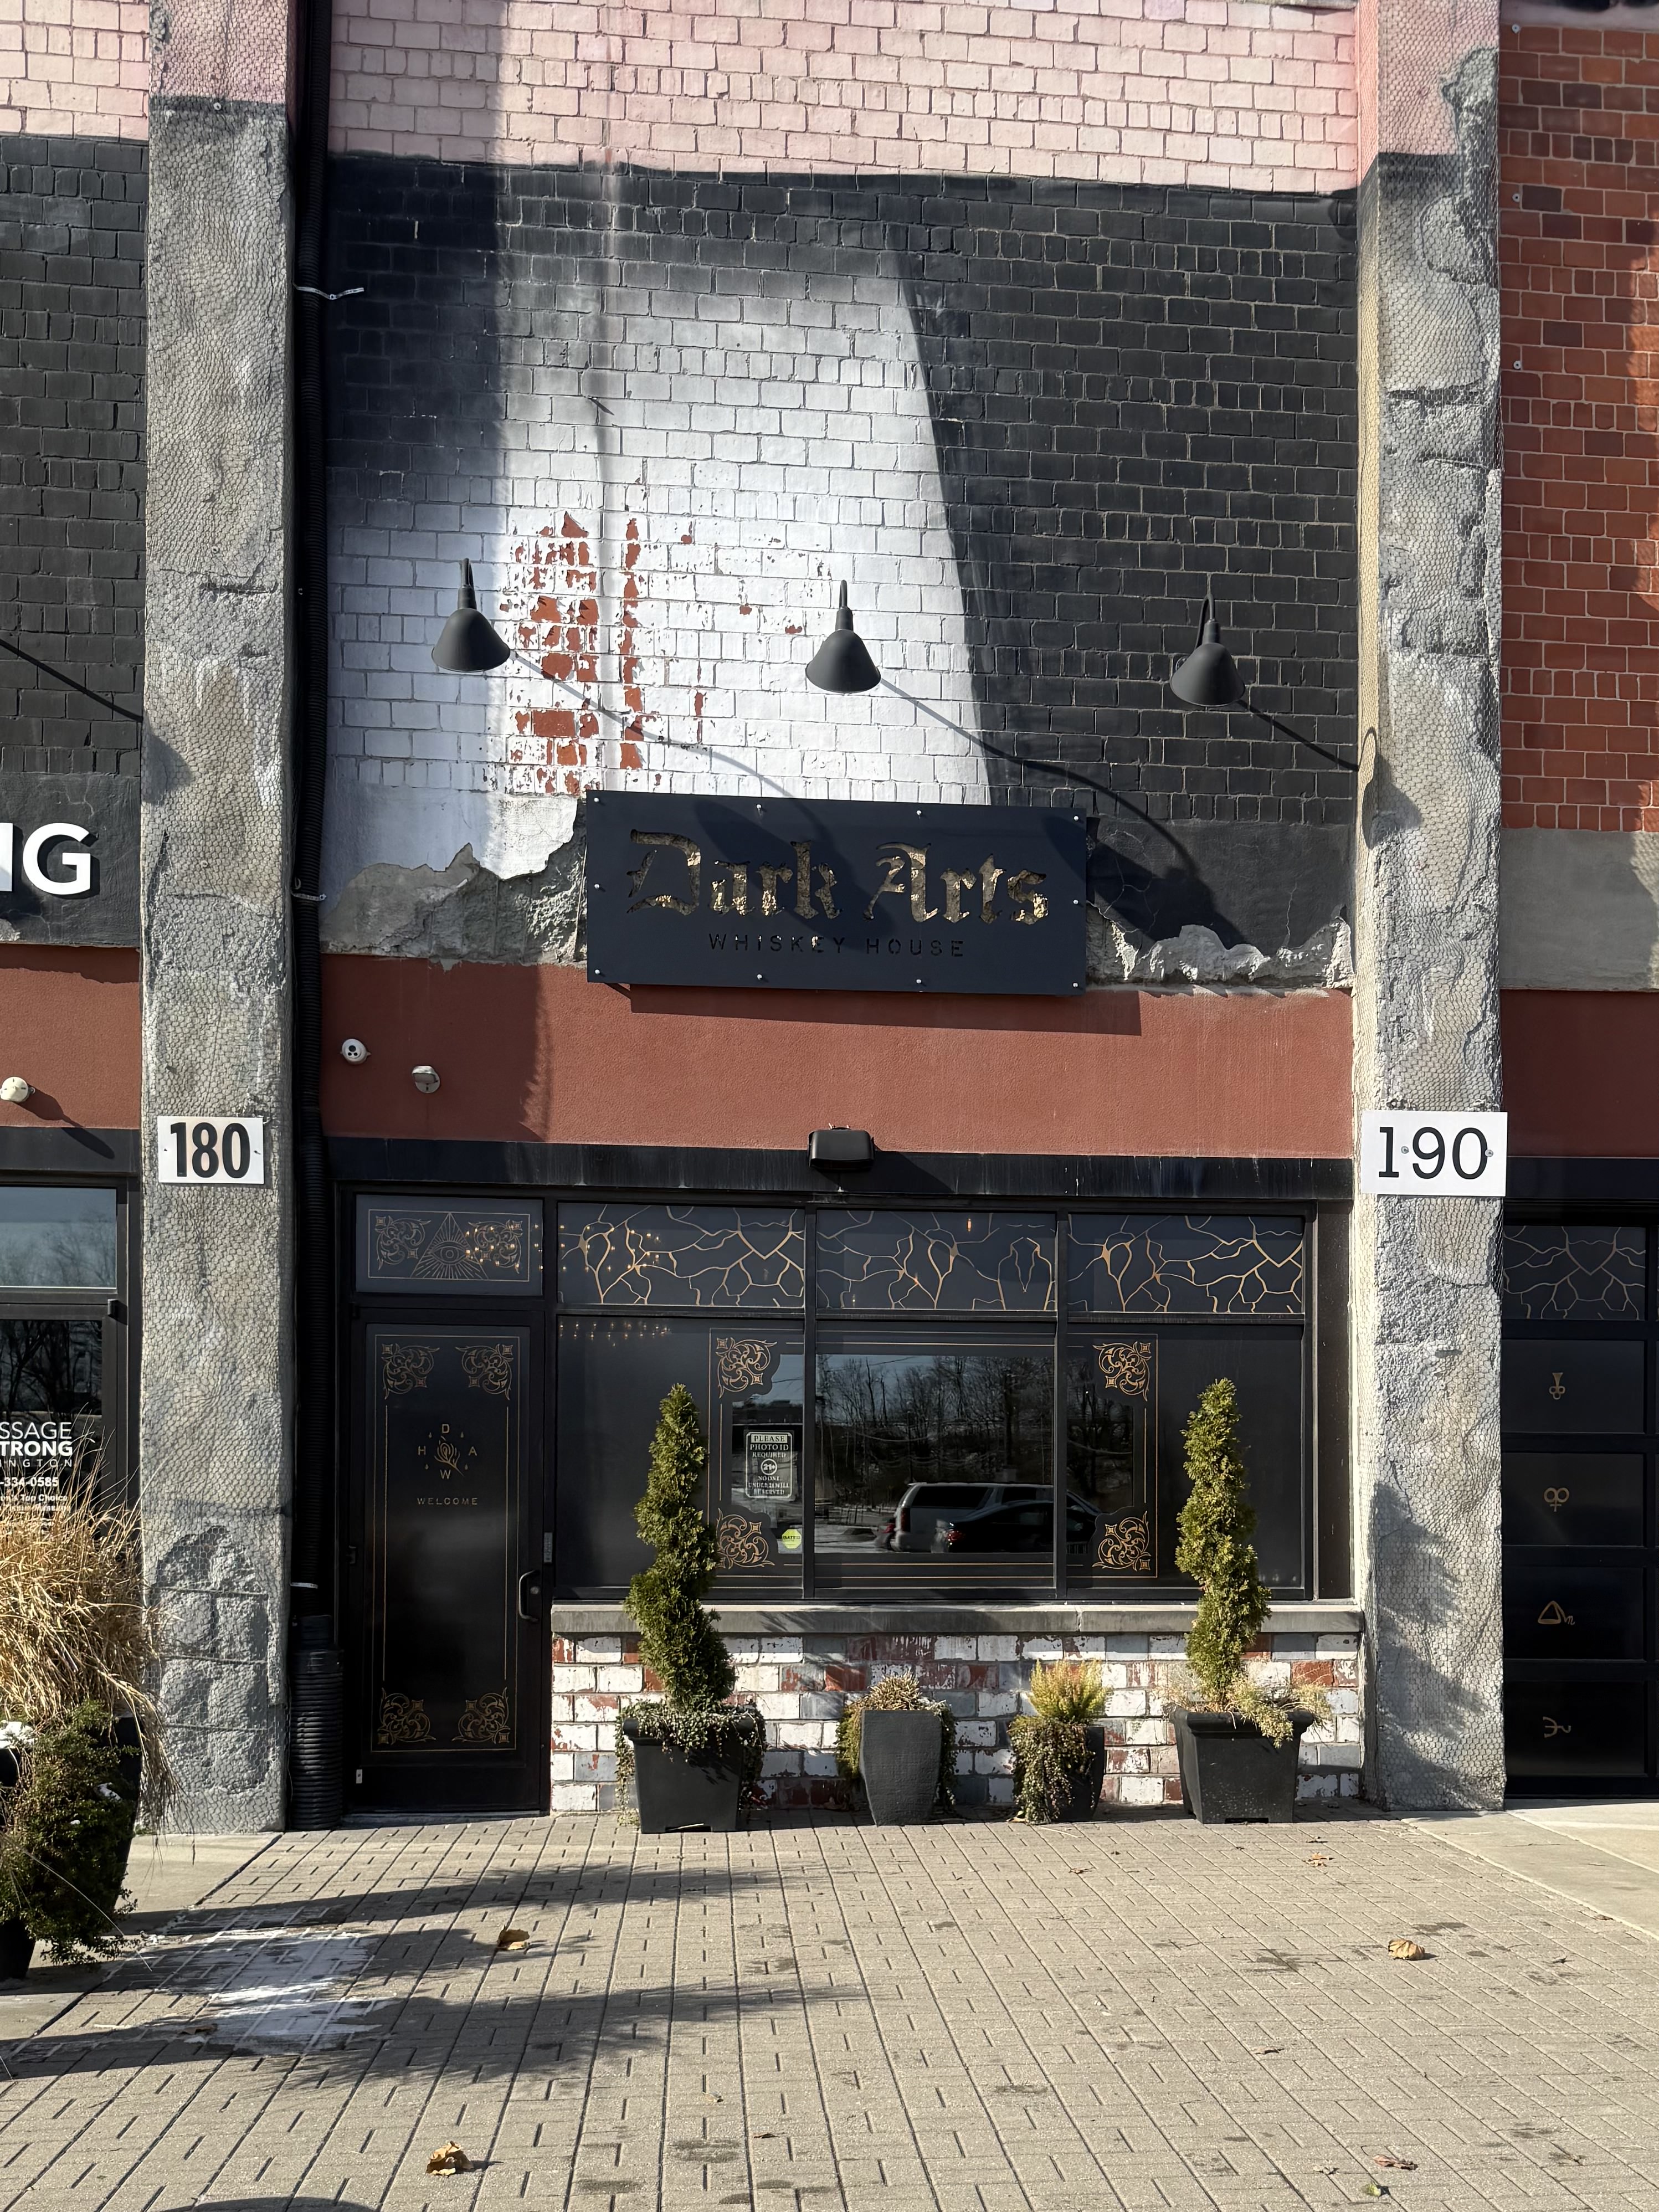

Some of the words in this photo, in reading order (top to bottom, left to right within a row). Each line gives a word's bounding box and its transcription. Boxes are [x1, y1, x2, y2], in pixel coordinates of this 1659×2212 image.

[626, 828, 844, 920] Dark
[862, 841, 1049, 925] Arts
[708, 933, 845, 953] WHISKEY
[867, 937, 964, 957] HOUSE
[170, 1122, 251, 1179] 180
[1379, 1126, 1488, 1180] 190
[441, 1424, 450, 1434] D
[0, 1440, 73, 1456] TRONG
[418, 1445, 427, 1456] H
[468, 1446, 477, 1456] A
[440, 1469, 451, 1480] W
